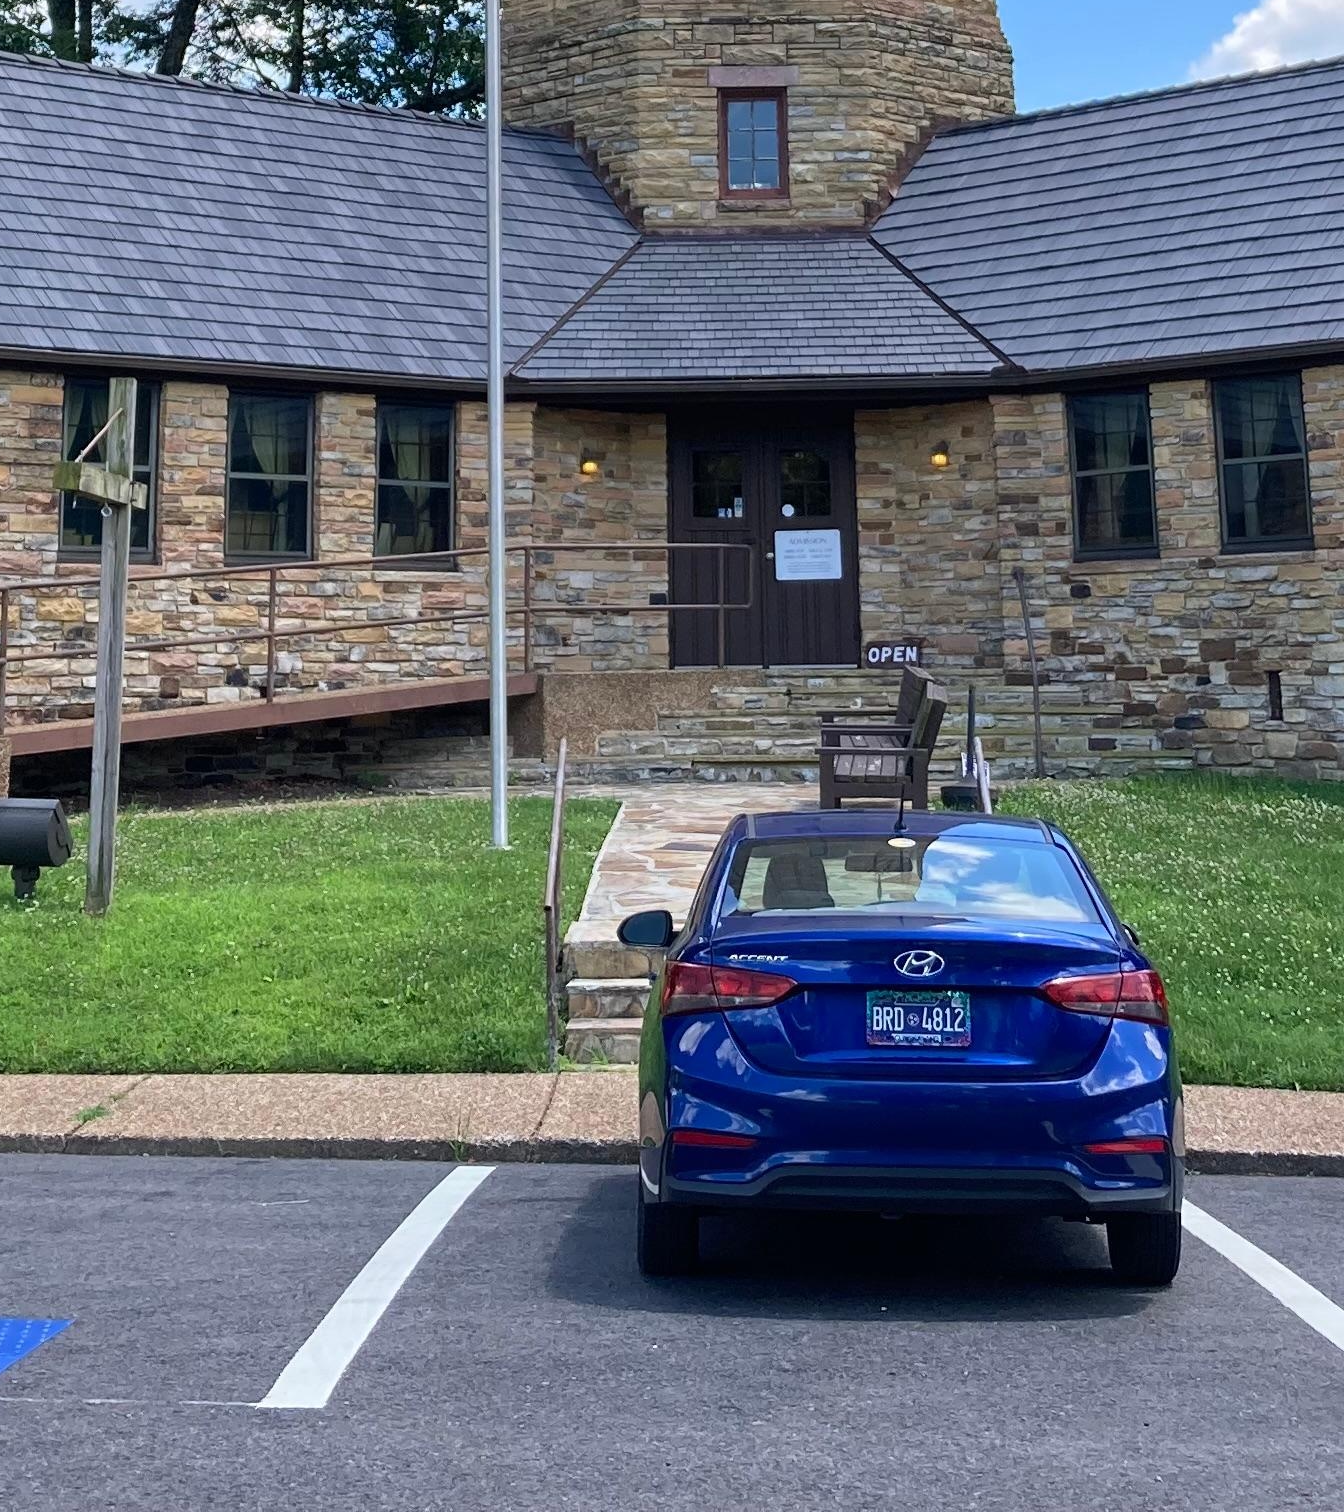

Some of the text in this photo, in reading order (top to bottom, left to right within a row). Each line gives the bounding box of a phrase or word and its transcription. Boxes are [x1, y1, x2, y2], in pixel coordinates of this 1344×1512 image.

[868, 646, 917, 663] OPEN
[728, 953, 789, 963] ACCENT
[872, 1006, 965, 1033] BRD 4812
